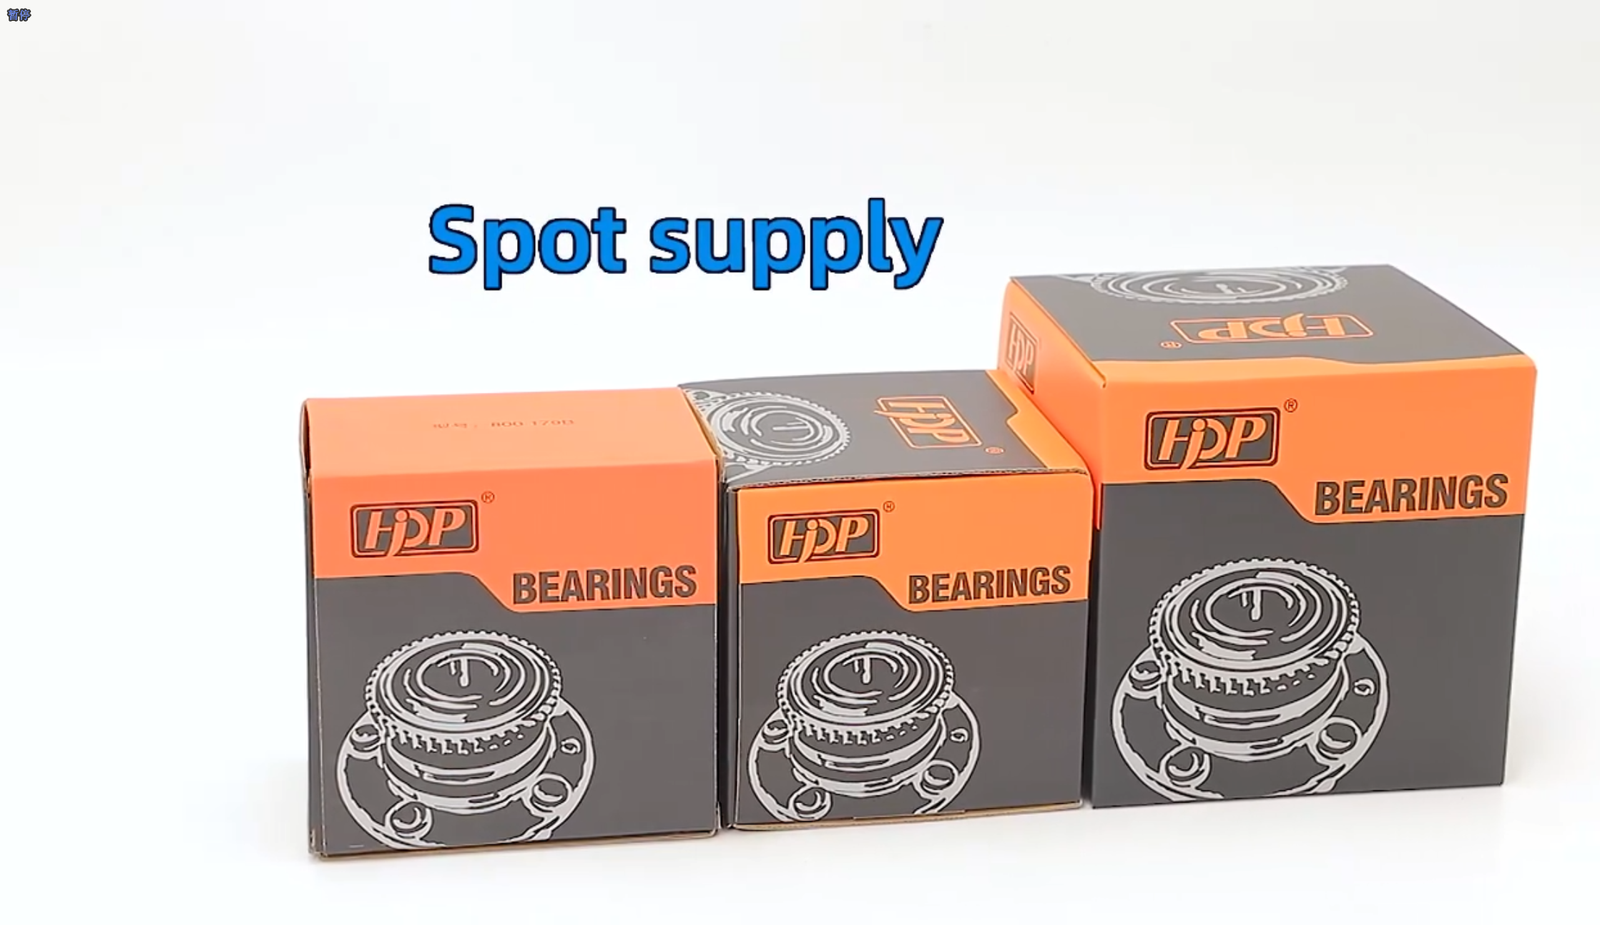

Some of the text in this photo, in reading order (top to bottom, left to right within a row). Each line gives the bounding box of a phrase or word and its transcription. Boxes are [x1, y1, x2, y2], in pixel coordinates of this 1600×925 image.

[1314, 473, 1509, 516] BEARINGS
[512, 564, 698, 605] BEARINGS
[908, 565, 1071, 605] BEARINGS
